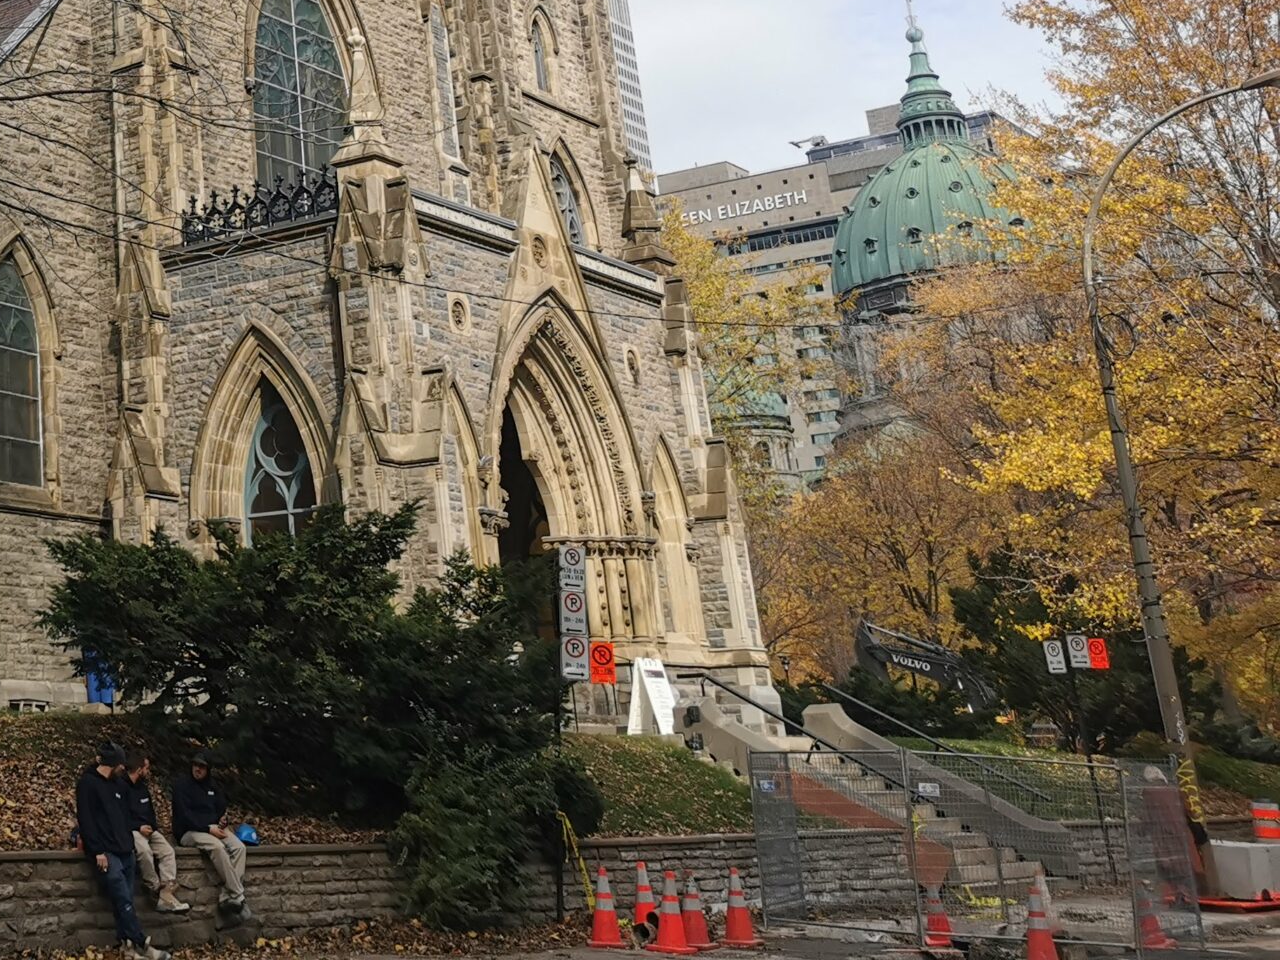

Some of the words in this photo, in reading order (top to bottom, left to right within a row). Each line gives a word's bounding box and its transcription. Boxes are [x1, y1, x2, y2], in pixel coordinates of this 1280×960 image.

[681, 208, 712, 227] EEN
[717, 189, 808, 220] ELIZABETH
[891, 653, 931, 671] VOLVO
